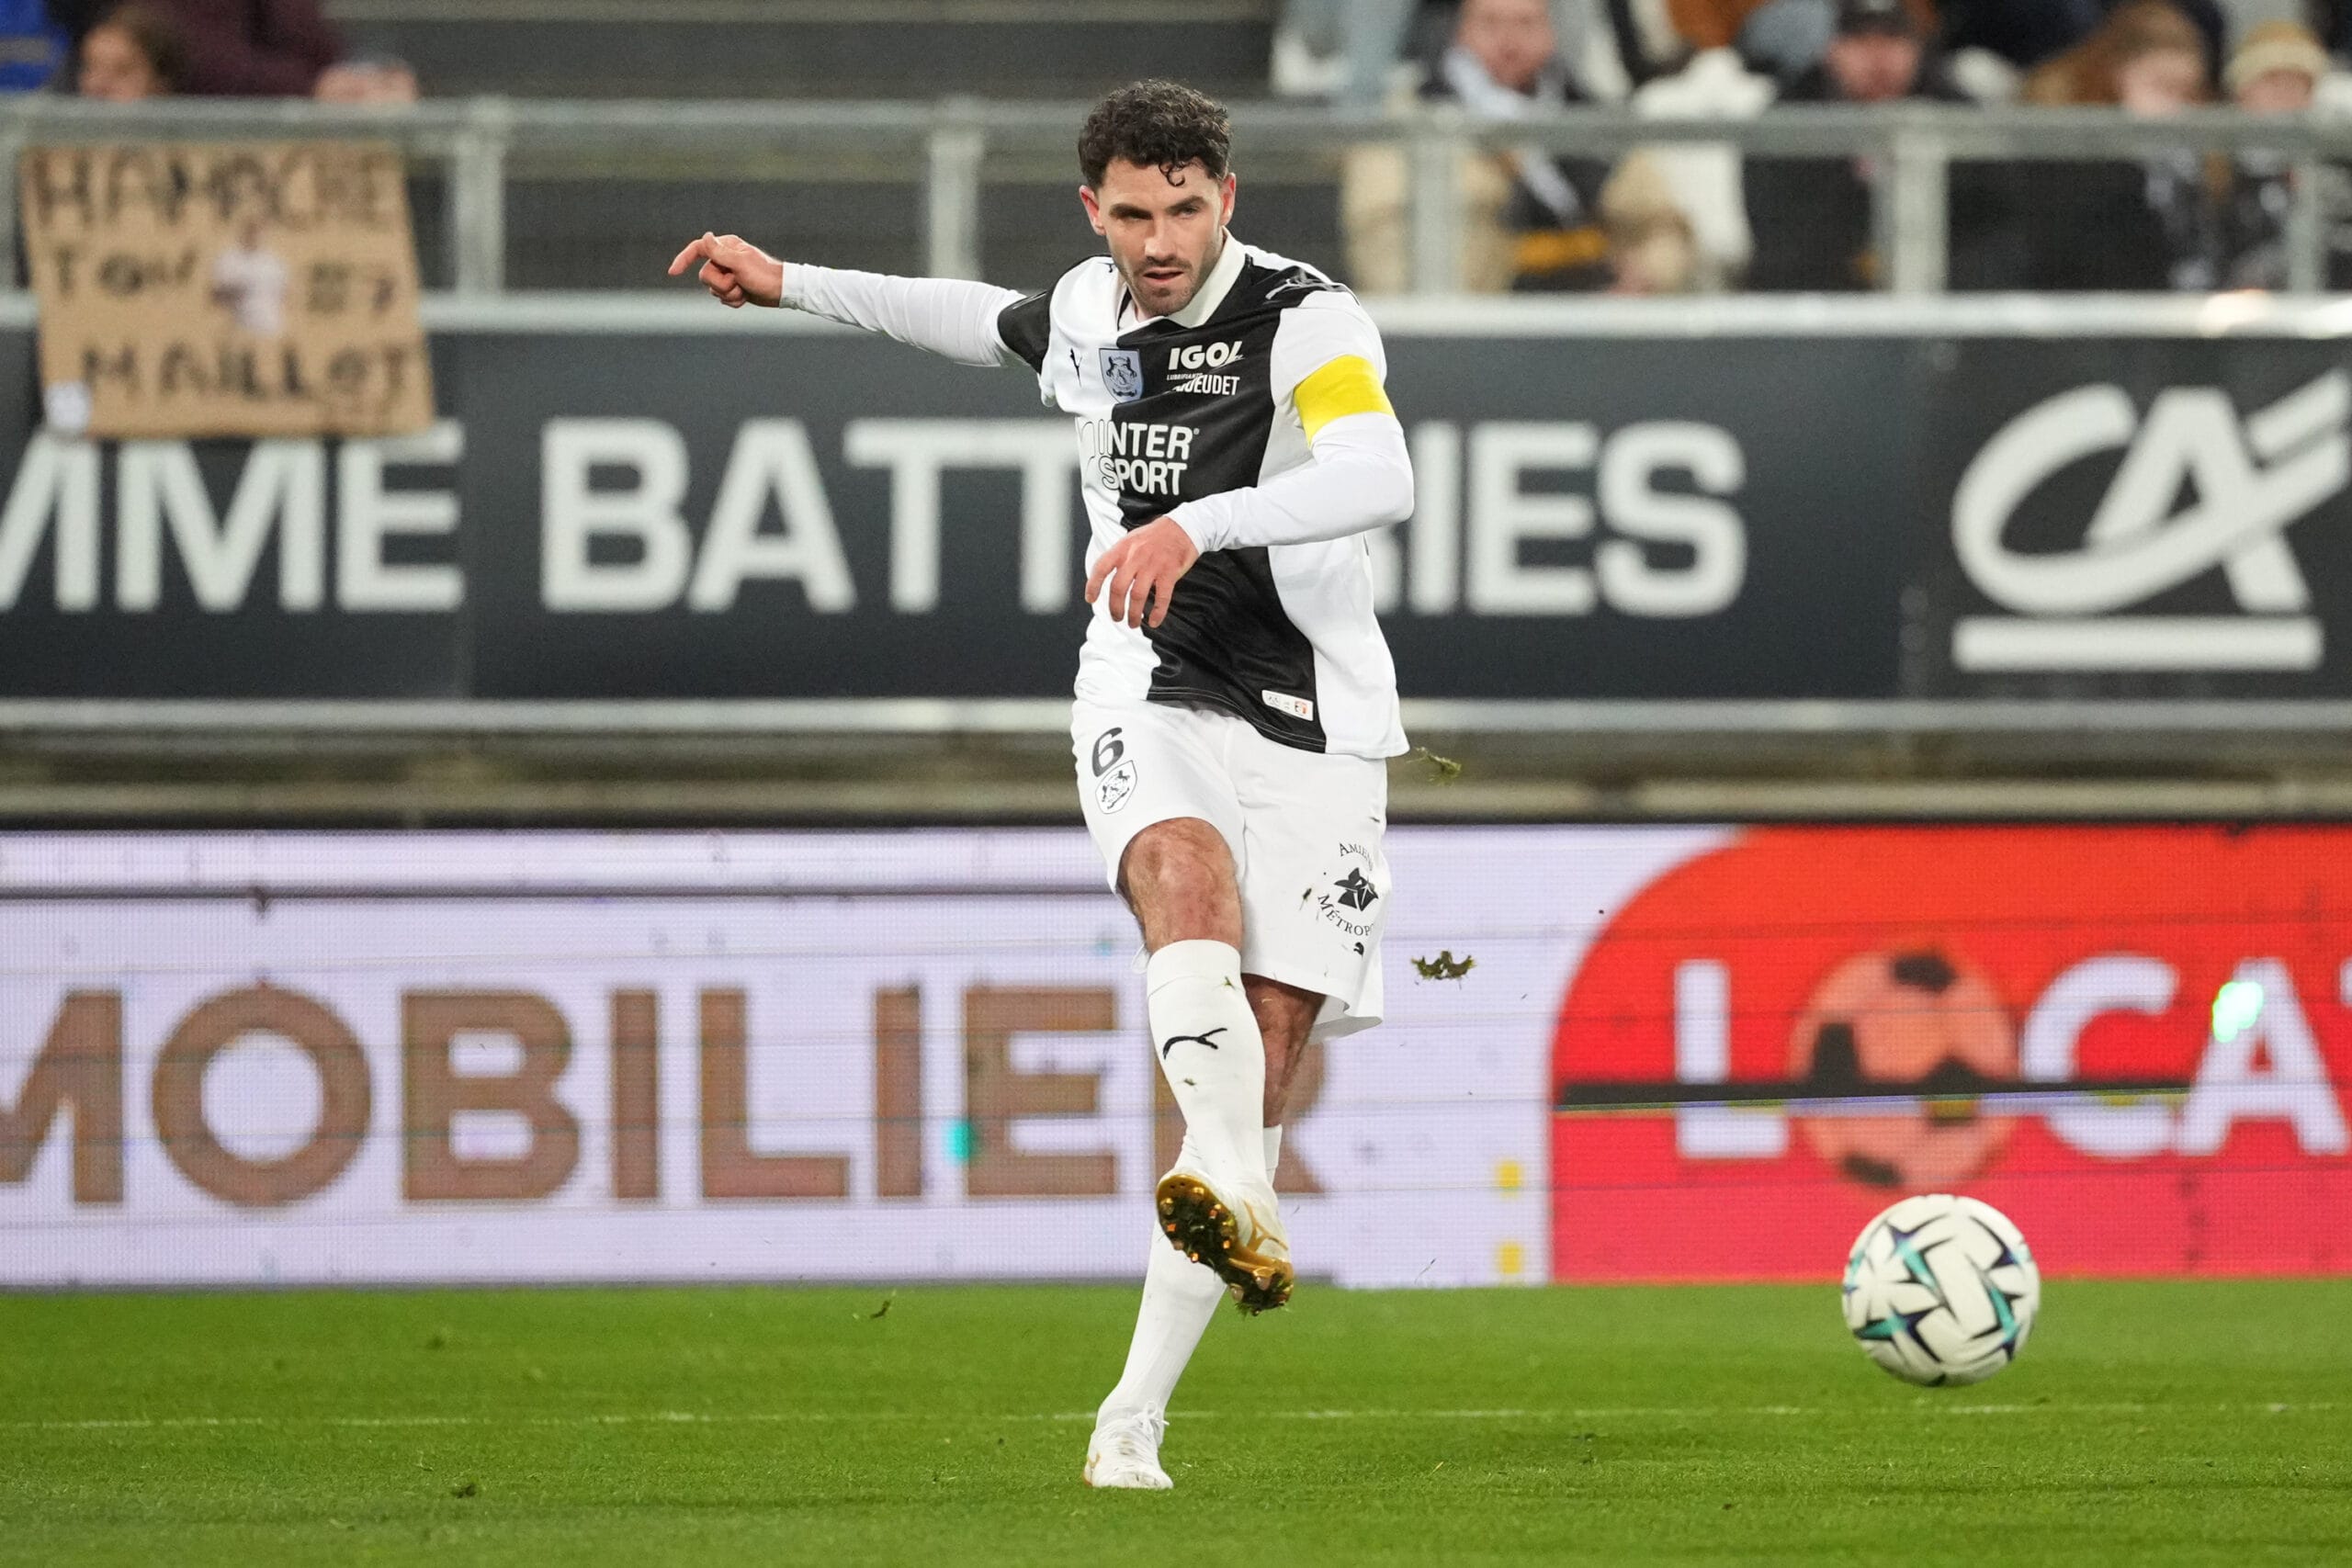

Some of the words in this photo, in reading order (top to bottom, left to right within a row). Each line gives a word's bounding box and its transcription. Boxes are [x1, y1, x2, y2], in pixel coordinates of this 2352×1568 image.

[1097, 418, 1193, 460] INTER
[1098, 455, 1188, 496] SPORT
[1091, 727, 1125, 778] 6
